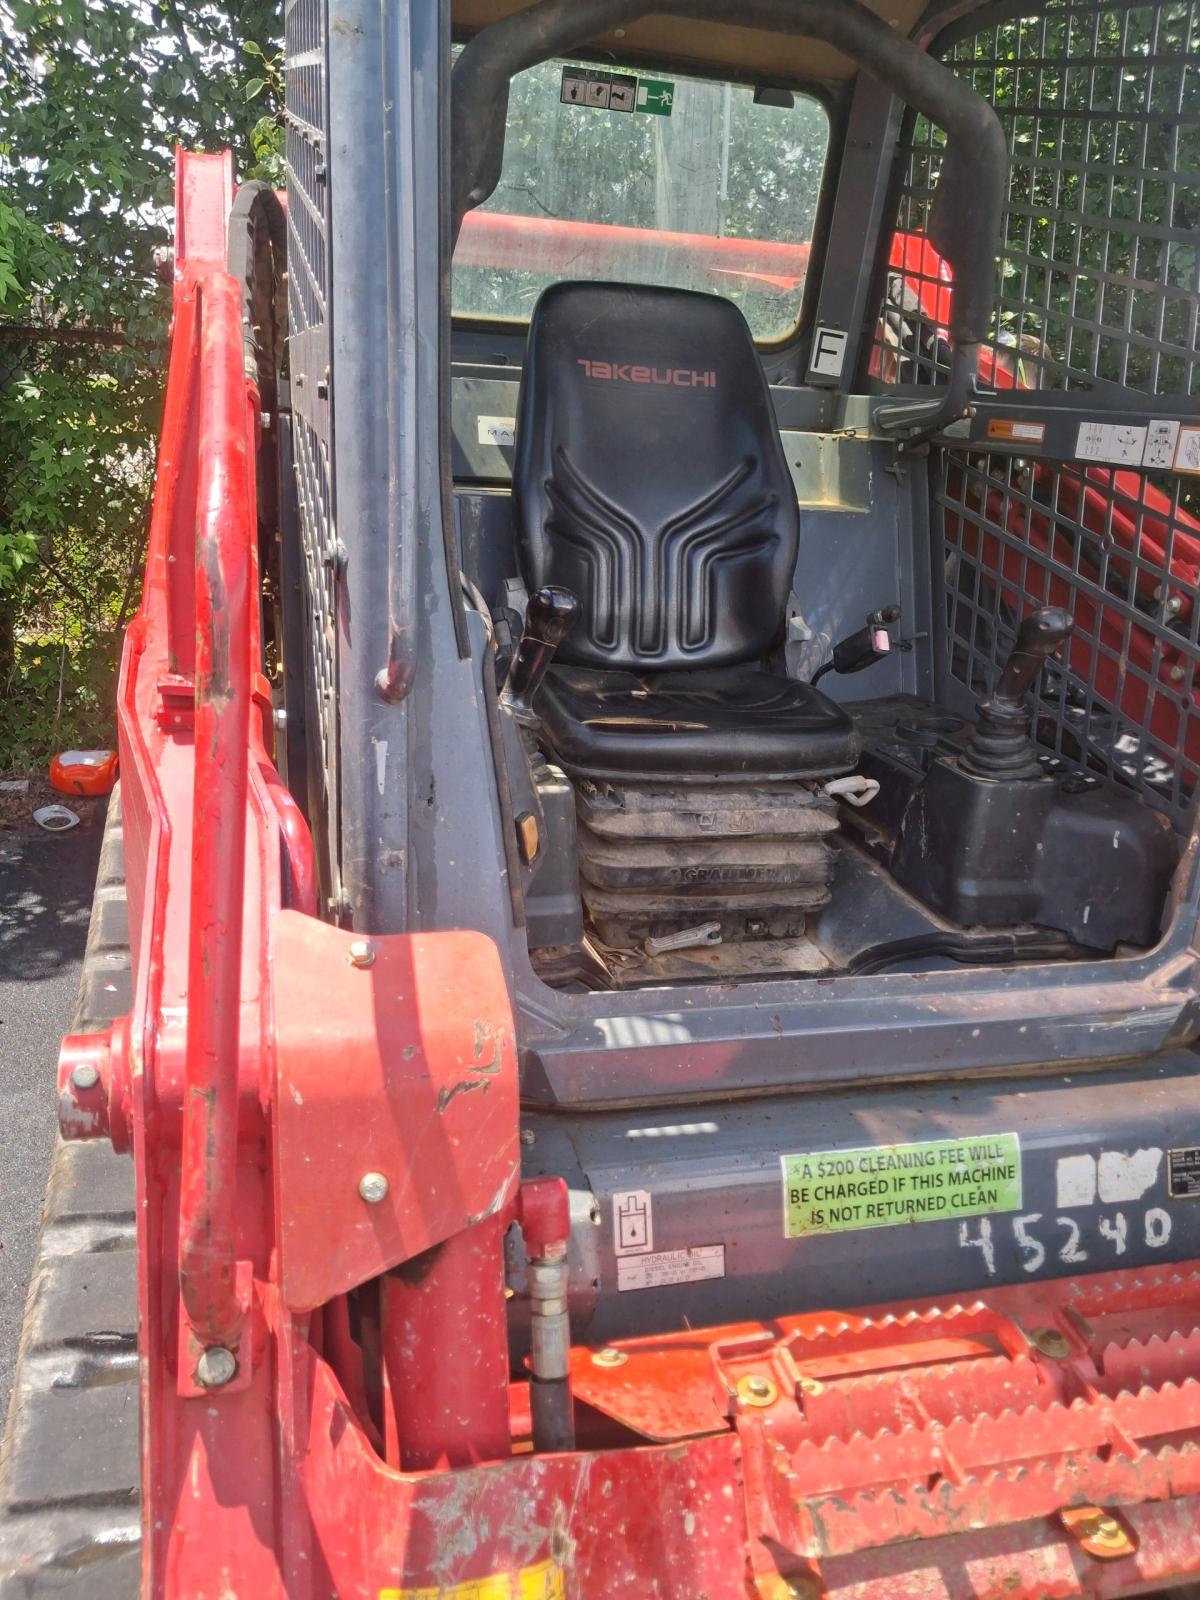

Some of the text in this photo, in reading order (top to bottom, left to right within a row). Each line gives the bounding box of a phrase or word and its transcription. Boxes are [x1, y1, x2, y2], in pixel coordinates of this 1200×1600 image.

[813, 331, 845, 369] F
[576, 358, 717, 388] TAKEUCHI
[802, 1144, 1004, 1180] A $200 CLEANING FEE WILL
[790, 1165, 1016, 1204] BE CHARGED IF THIS MACHINE
[811, 1189, 998, 1225] IS NOT RETURNED CLEAN
[641, 1252, 686, 1265] HYDRAULIC
[959, 1207, 1172, 1276] 45240
